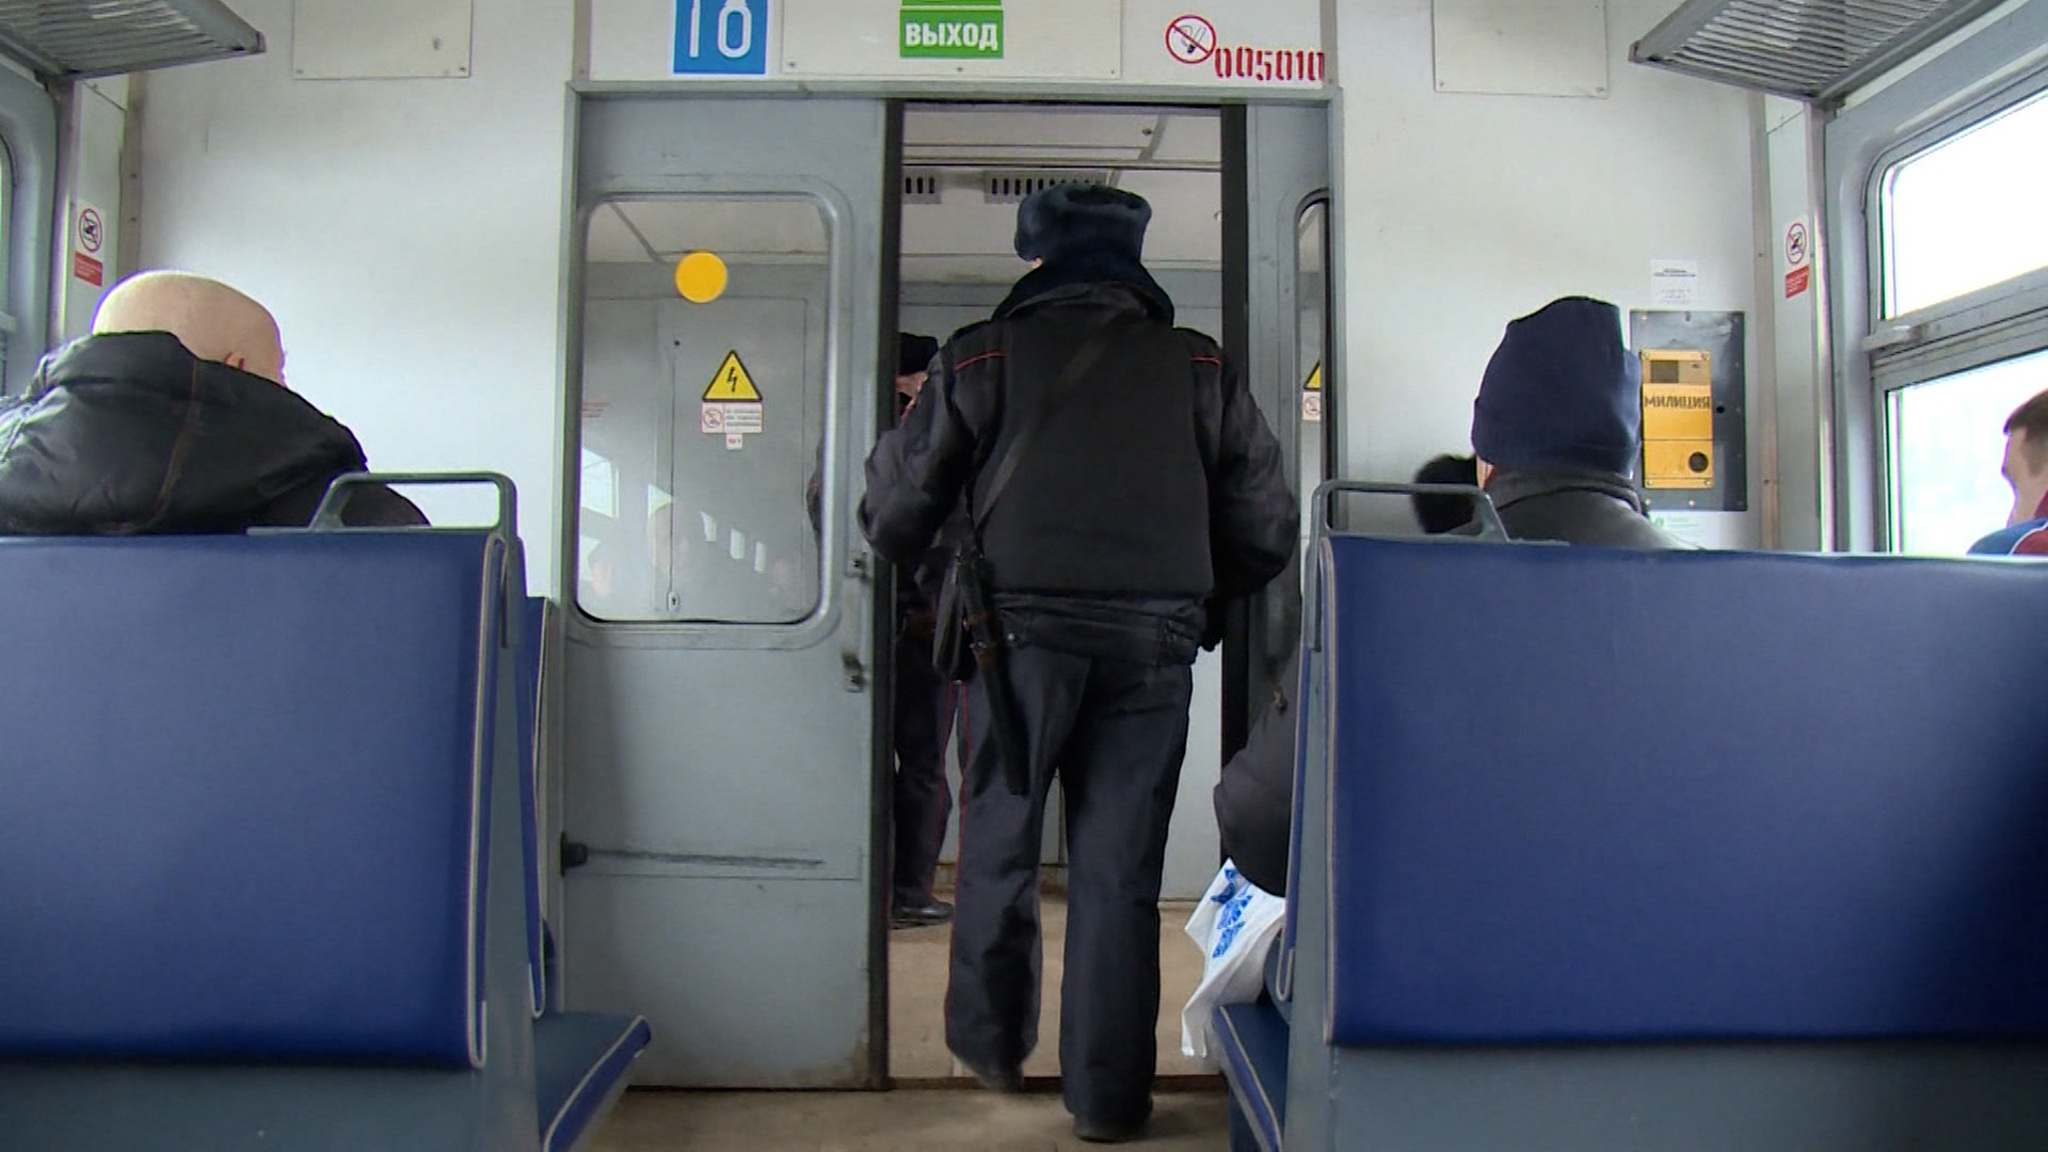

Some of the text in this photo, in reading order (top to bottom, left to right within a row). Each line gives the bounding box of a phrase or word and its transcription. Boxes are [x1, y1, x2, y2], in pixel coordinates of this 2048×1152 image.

[905, 22, 998, 51] ВЫХОД
[1214, 46, 1325, 81] 005010
[1643, 395, 1711, 409] МИЛИЦИЯ
